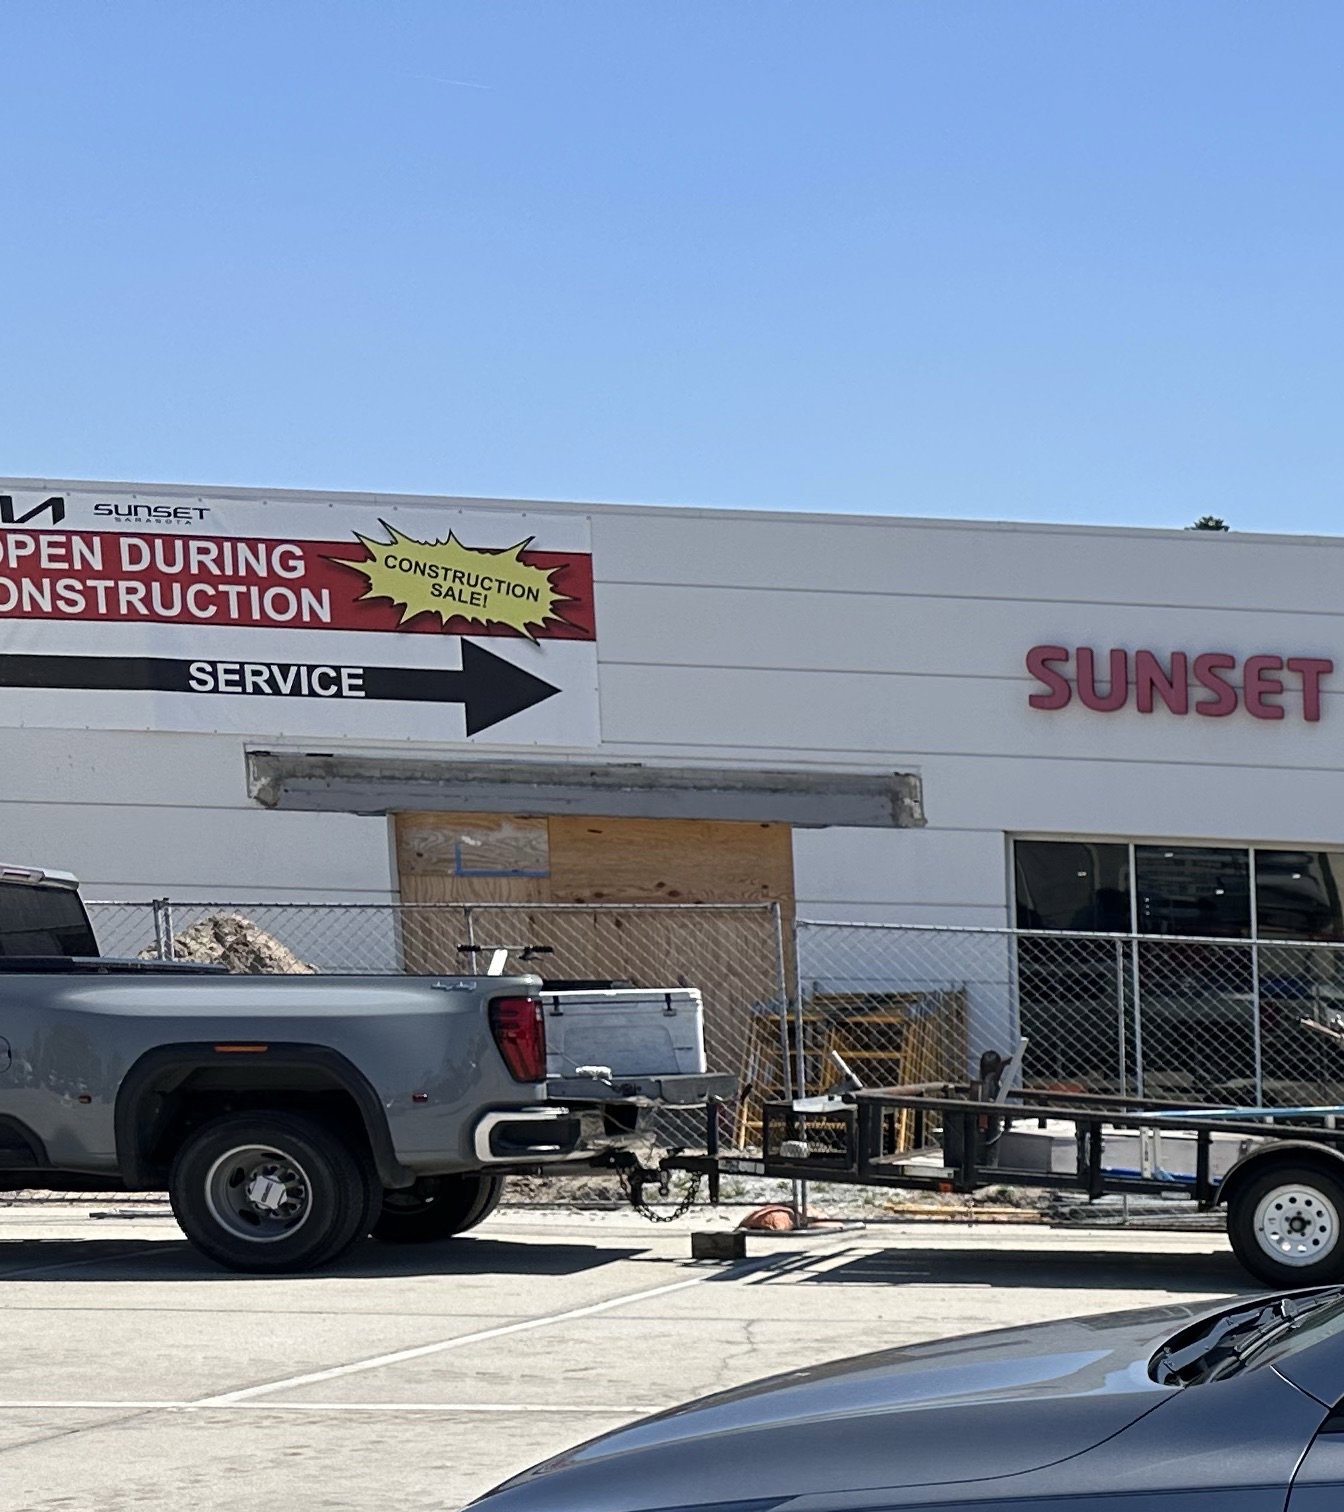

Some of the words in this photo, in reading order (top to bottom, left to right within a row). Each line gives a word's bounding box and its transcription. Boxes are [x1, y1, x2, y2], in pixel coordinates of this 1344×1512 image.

[0, 495, 65, 525] IA
[93, 503, 211, 520] SUNSET
[0, 534, 103, 571] PEN
[119, 537, 306, 579] DURING
[384, 554, 541, 603] CONSTRUCTION
[430, 582, 489, 608] SALE!
[0, 576, 331, 623] ONSTRUCTION
[188, 661, 366, 698] SERVICE
[1026, 645, 1334, 722] SUNSET
